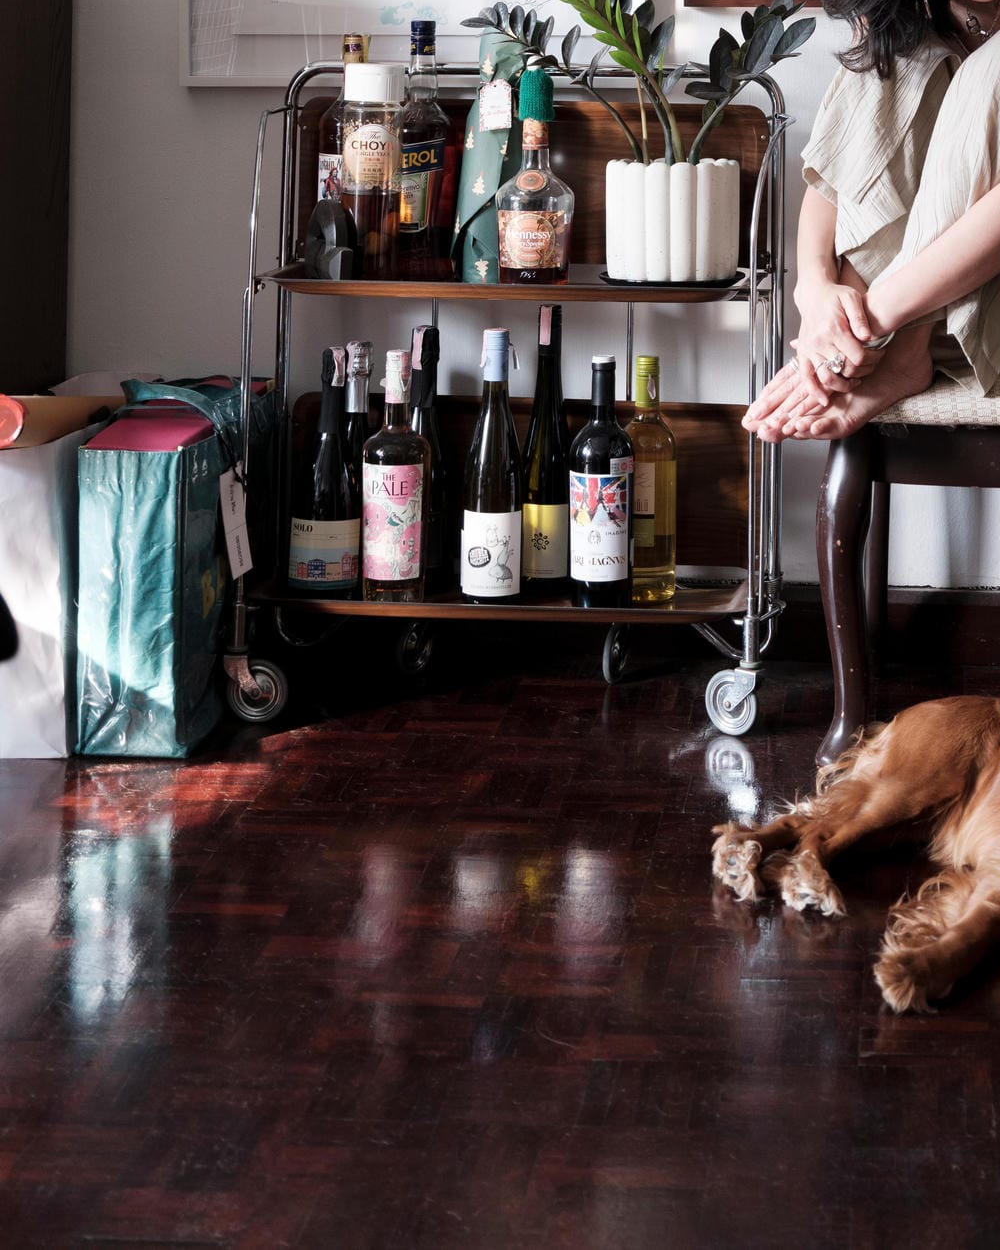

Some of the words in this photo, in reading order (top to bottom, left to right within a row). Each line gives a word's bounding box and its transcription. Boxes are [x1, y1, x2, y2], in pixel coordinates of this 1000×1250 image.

[400, 149, 438, 168] EROL
[382, 473, 397, 481] THE
[371, 480, 409, 496] PALE
[293, 523, 313, 533] SOLO
